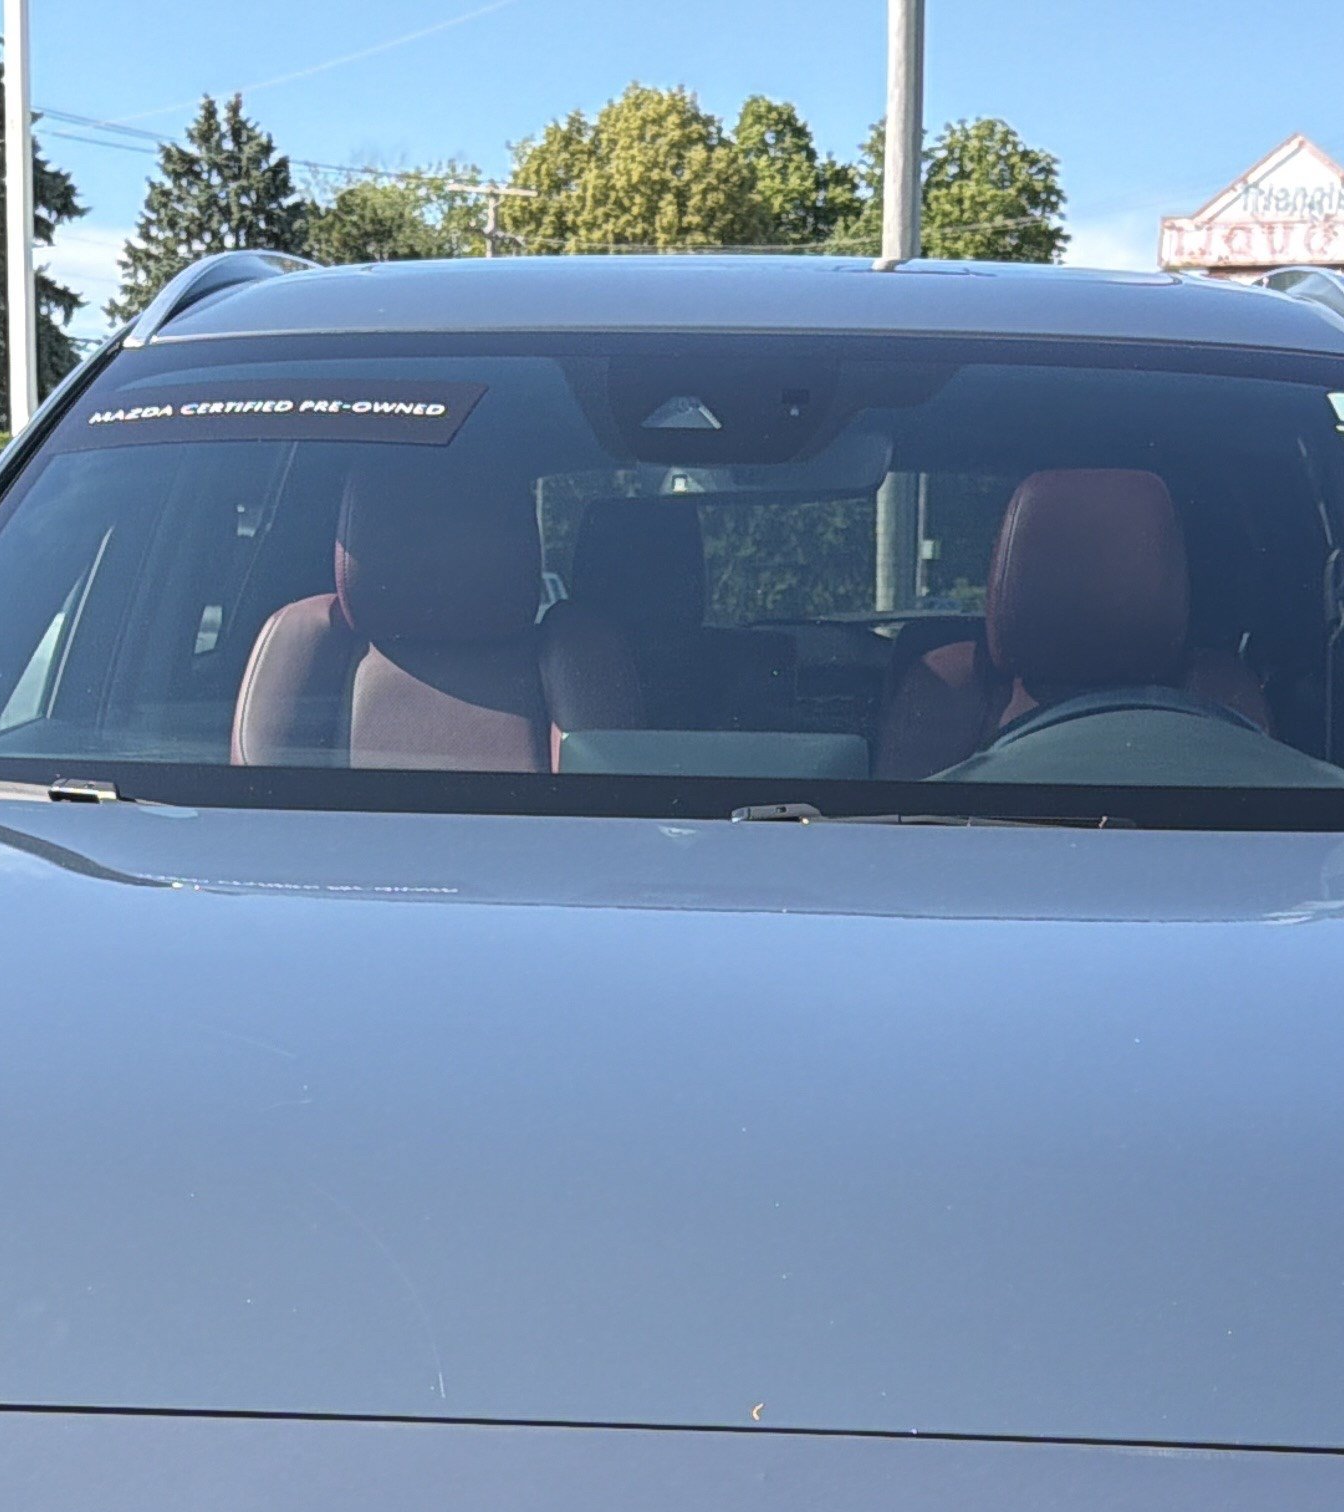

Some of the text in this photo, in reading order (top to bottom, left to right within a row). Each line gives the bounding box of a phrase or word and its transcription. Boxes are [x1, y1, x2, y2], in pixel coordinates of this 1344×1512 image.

[88, 400, 447, 425] MAZDA CERTIFIED PRE-OWNED
